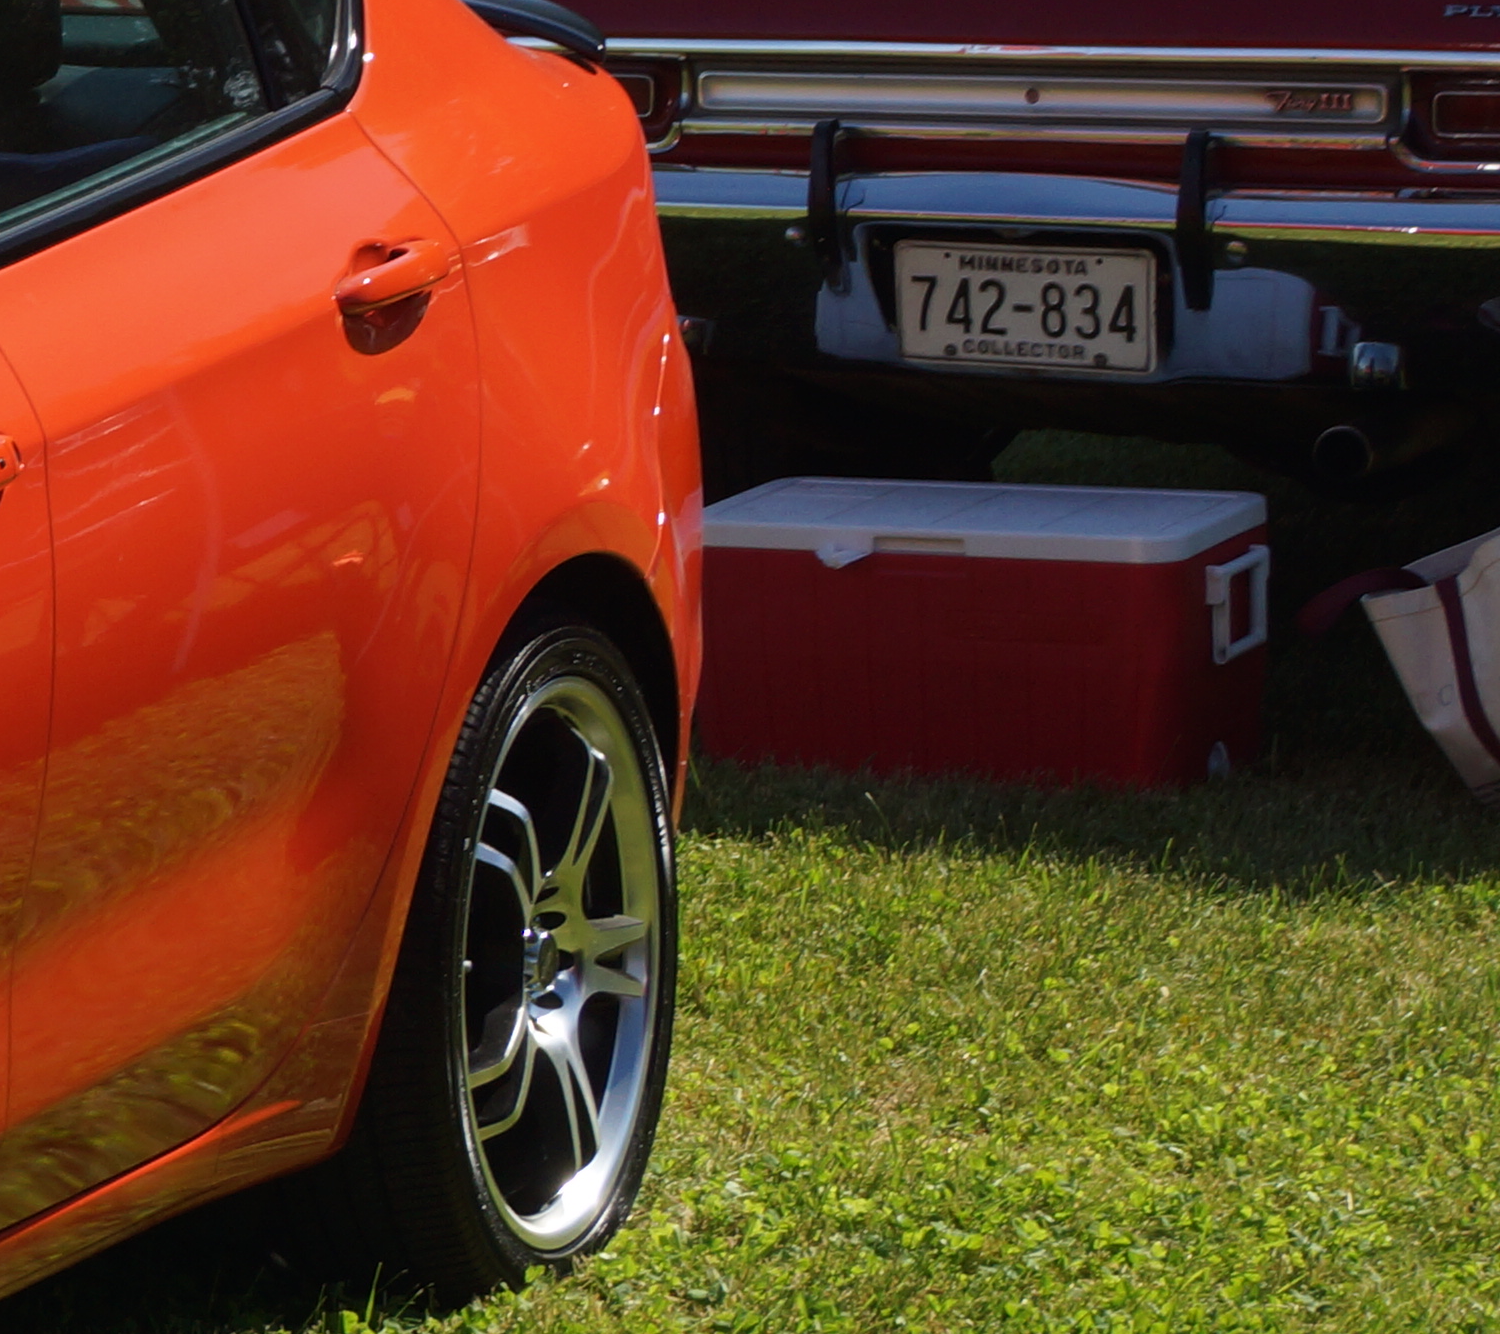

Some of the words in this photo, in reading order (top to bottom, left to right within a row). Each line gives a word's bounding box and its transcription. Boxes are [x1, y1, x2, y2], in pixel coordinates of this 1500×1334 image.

[959, 254, 1089, 276] MINNESOTA
[910, 275, 1137, 343] 742-834
[963, 339, 1086, 359] COLLECTOR
